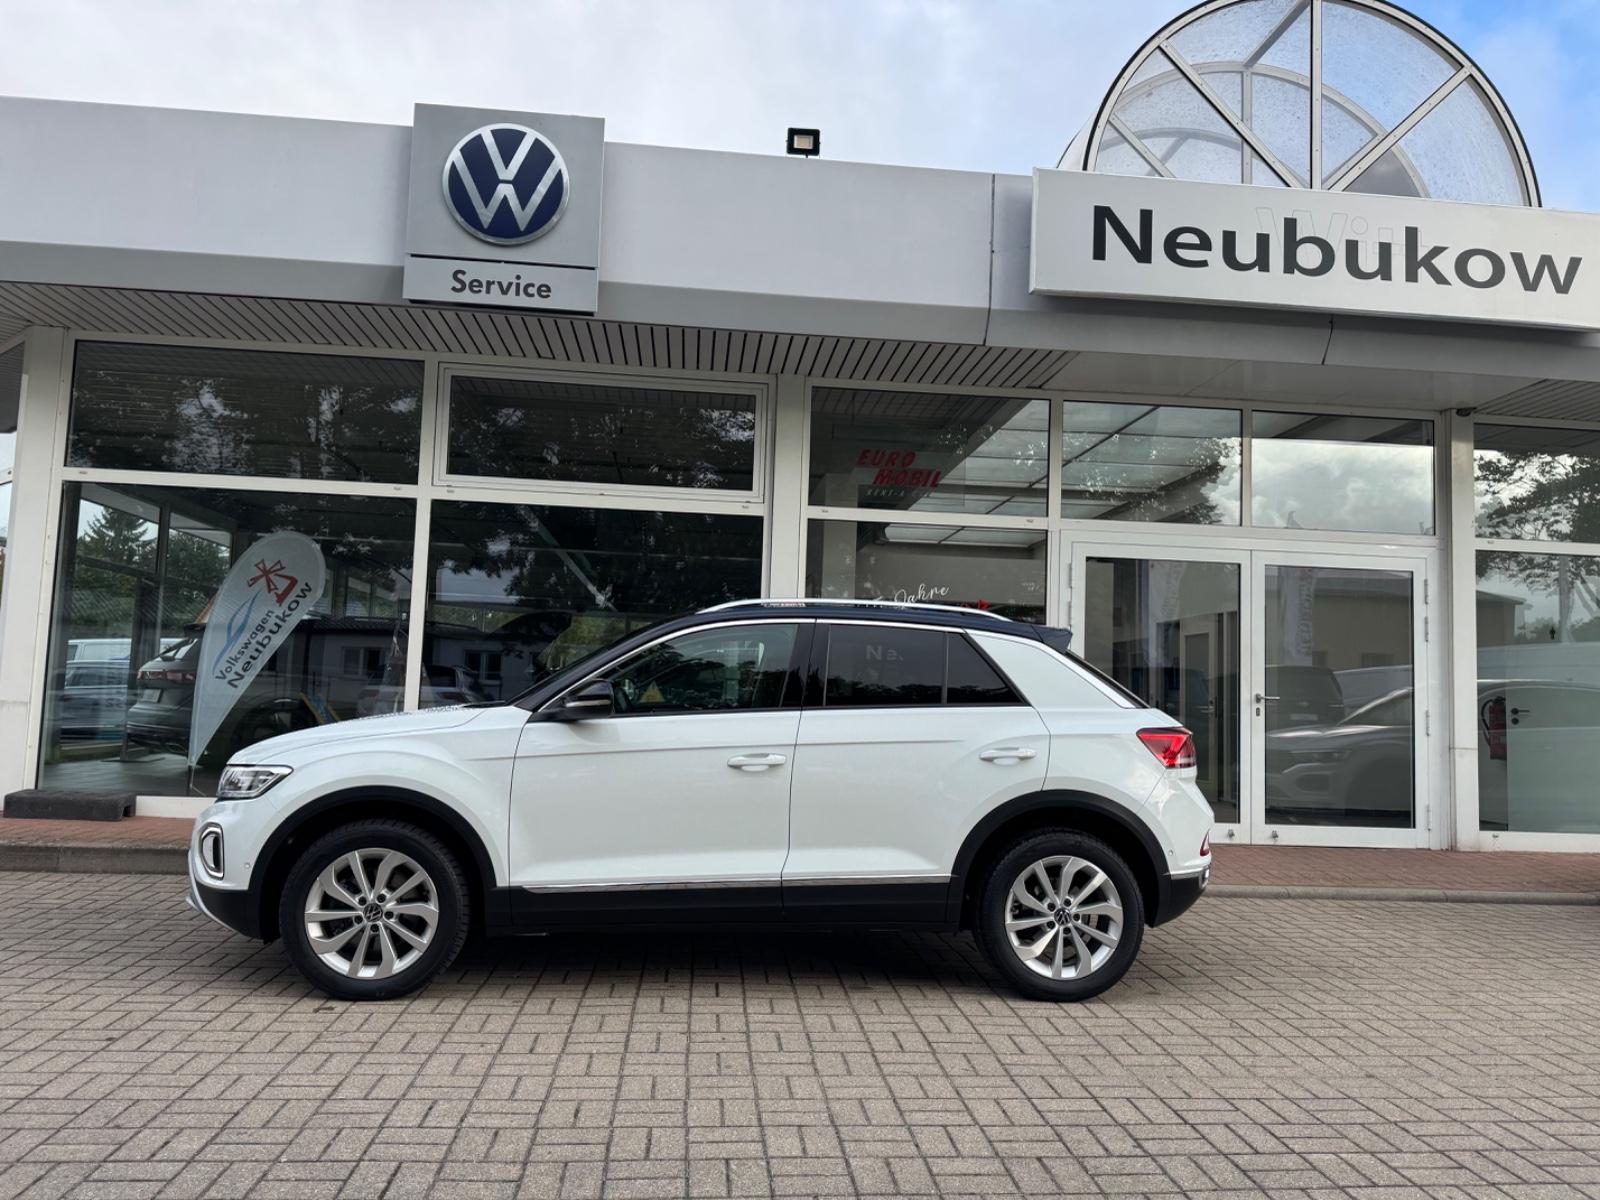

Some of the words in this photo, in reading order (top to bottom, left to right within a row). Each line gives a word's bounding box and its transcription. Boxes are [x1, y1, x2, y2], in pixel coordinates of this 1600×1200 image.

[442, 123, 569, 246] VW
[451, 269, 552, 299] Service
[1092, 203, 1583, 295] Neubukow
[856, 448, 916, 468] EURO
[872, 468, 942, 488] MOBIL
[215, 609, 275, 681] Volkswagen
[227, 582, 312, 688] Neubukow
